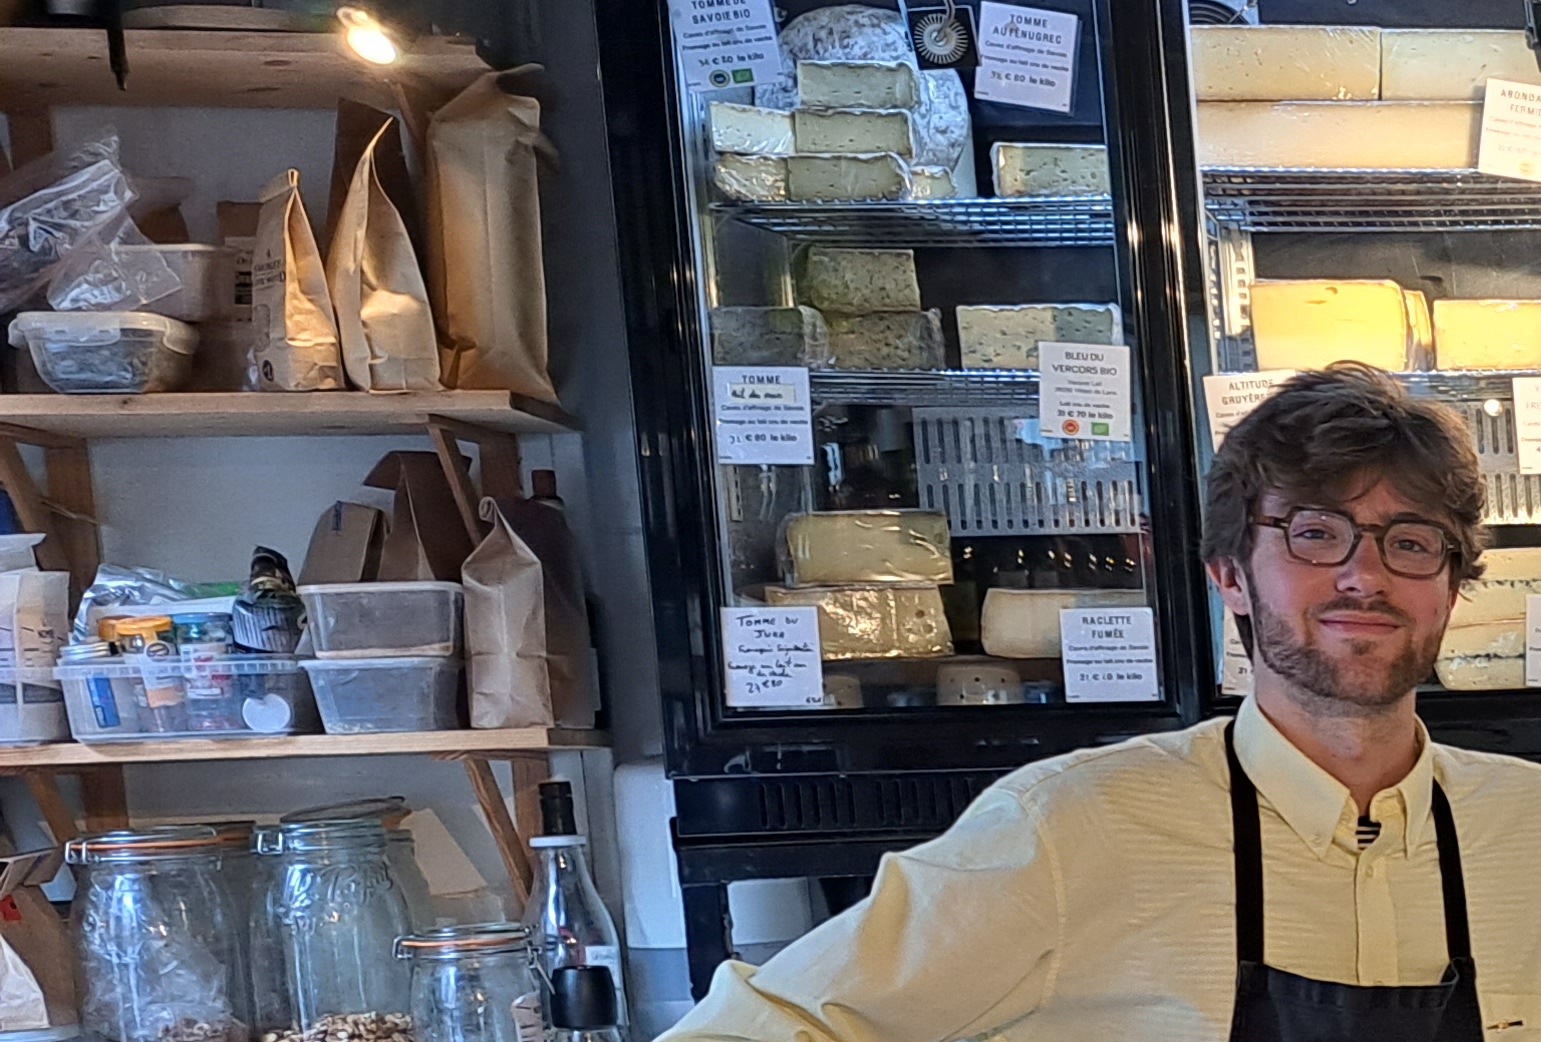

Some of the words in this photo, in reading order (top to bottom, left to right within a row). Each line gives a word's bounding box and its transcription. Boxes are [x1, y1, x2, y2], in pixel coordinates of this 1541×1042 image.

[691, 11, 731, 24] SAVOIE
[733, 9, 751, 19] BIO
[1010, 14, 1048, 28] TOMME
[993, 26, 1009, 37] AU
[1065, 352, 1089, 362] BLEU
[1090, 353, 1105, 362] DU
[1051, 363, 1098, 375] VERCORS
[1100, 366, 1118, 376] BIO
[742, 375, 782, 385] TOMME
[1081, 615, 1132, 626] RACLETTE
[1092, 628, 1125, 640] FUMÉE
